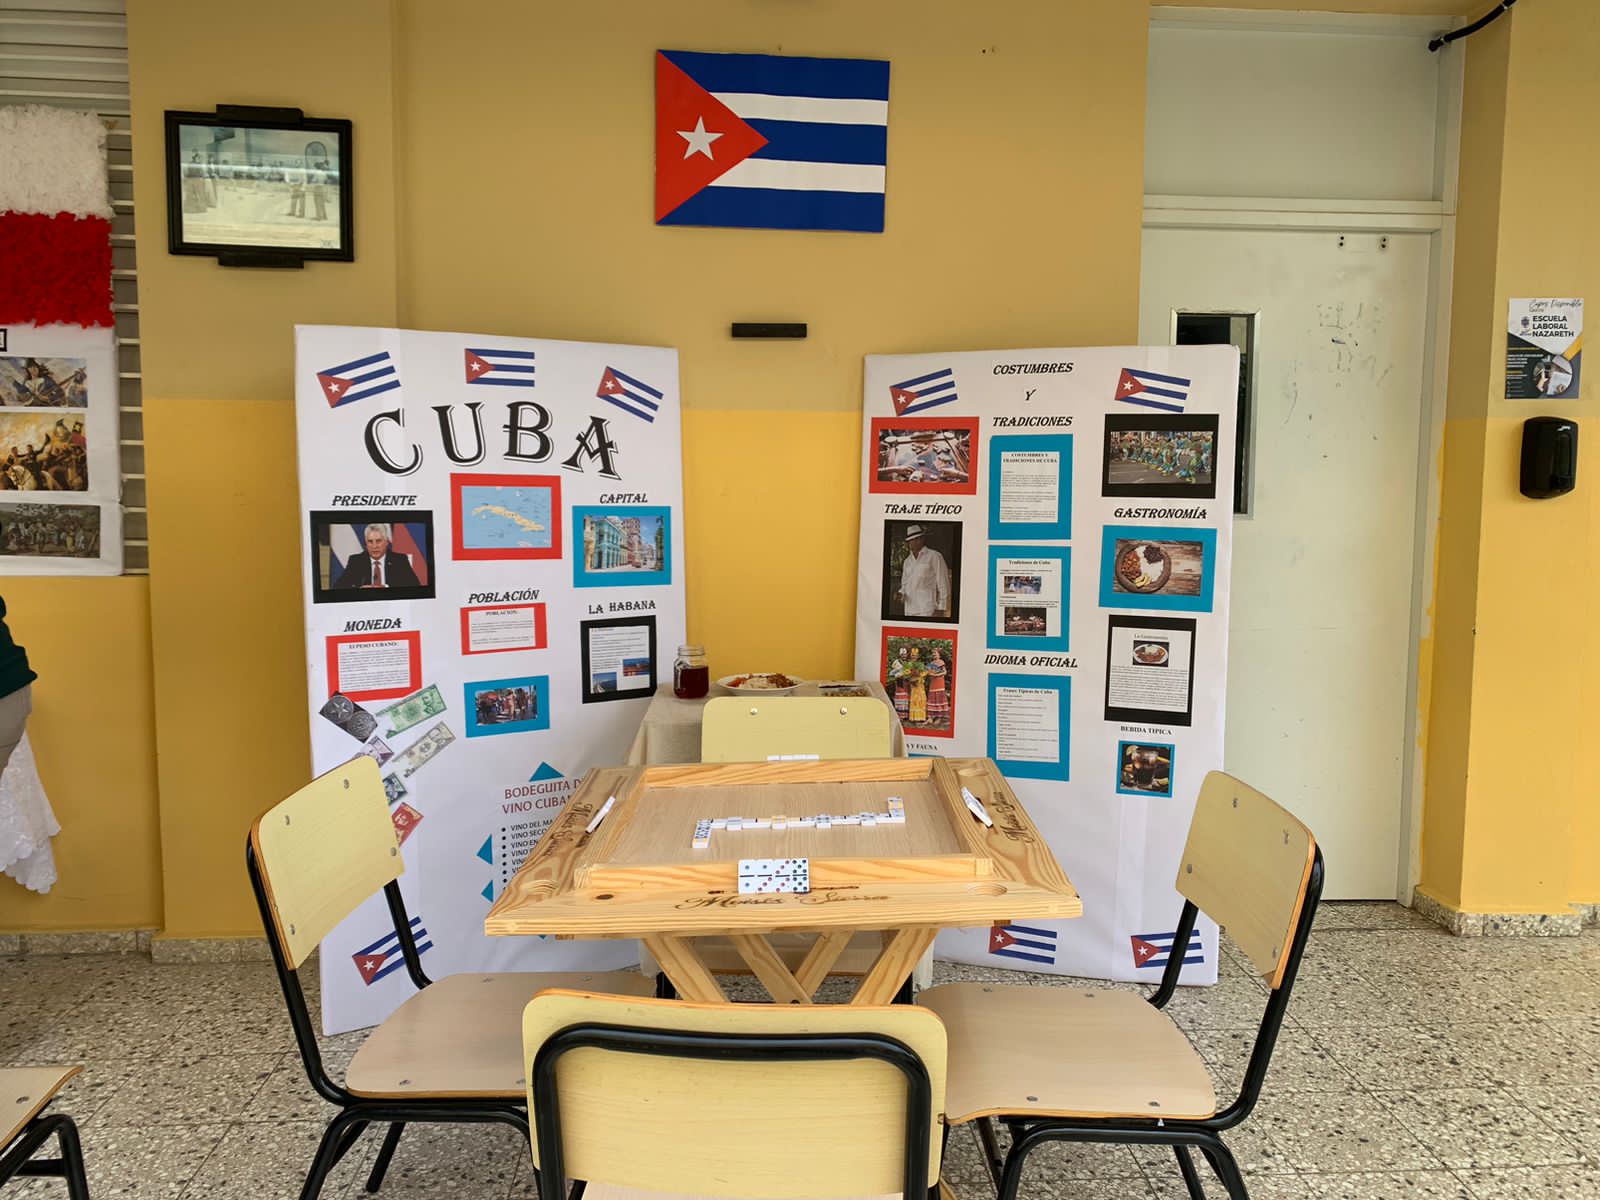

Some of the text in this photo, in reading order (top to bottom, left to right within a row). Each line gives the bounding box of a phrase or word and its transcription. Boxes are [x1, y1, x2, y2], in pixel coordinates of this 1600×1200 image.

[993, 362, 1074, 375] COSTUMBRES
[1025, 388, 1037, 401] Y
[993, 416, 1073, 427] TRADICIONES
[364, 401, 622, 481] CUBA
[332, 495, 417, 506] PRESIDENTE
[600, 493, 648, 504] CAPITAL
[884, 502, 962, 515] TRAJE TÍPICO
[1114, 506, 1207, 519] GASTRONOMÍA
[468, 587, 540, 604] POBLACIÓN
[588, 600, 657, 615] LA HABANA
[344, 618, 402, 632] MONEDA
[984, 654, 1078, 668] IDIOMA OFICIAL
[1120, 725, 1146, 733] BEBIDA
[916, 743, 938, 751] FAUNA
[504, 780, 570, 799] BODEGUITA
[502, 795, 571, 814] VINO CUBA
[510, 823, 528, 831] VINO
[529, 820, 541, 829] DEL
[511, 831, 528, 839] VINO
[510, 840, 528, 848] VINO
[511, 849, 528, 857] VINO
